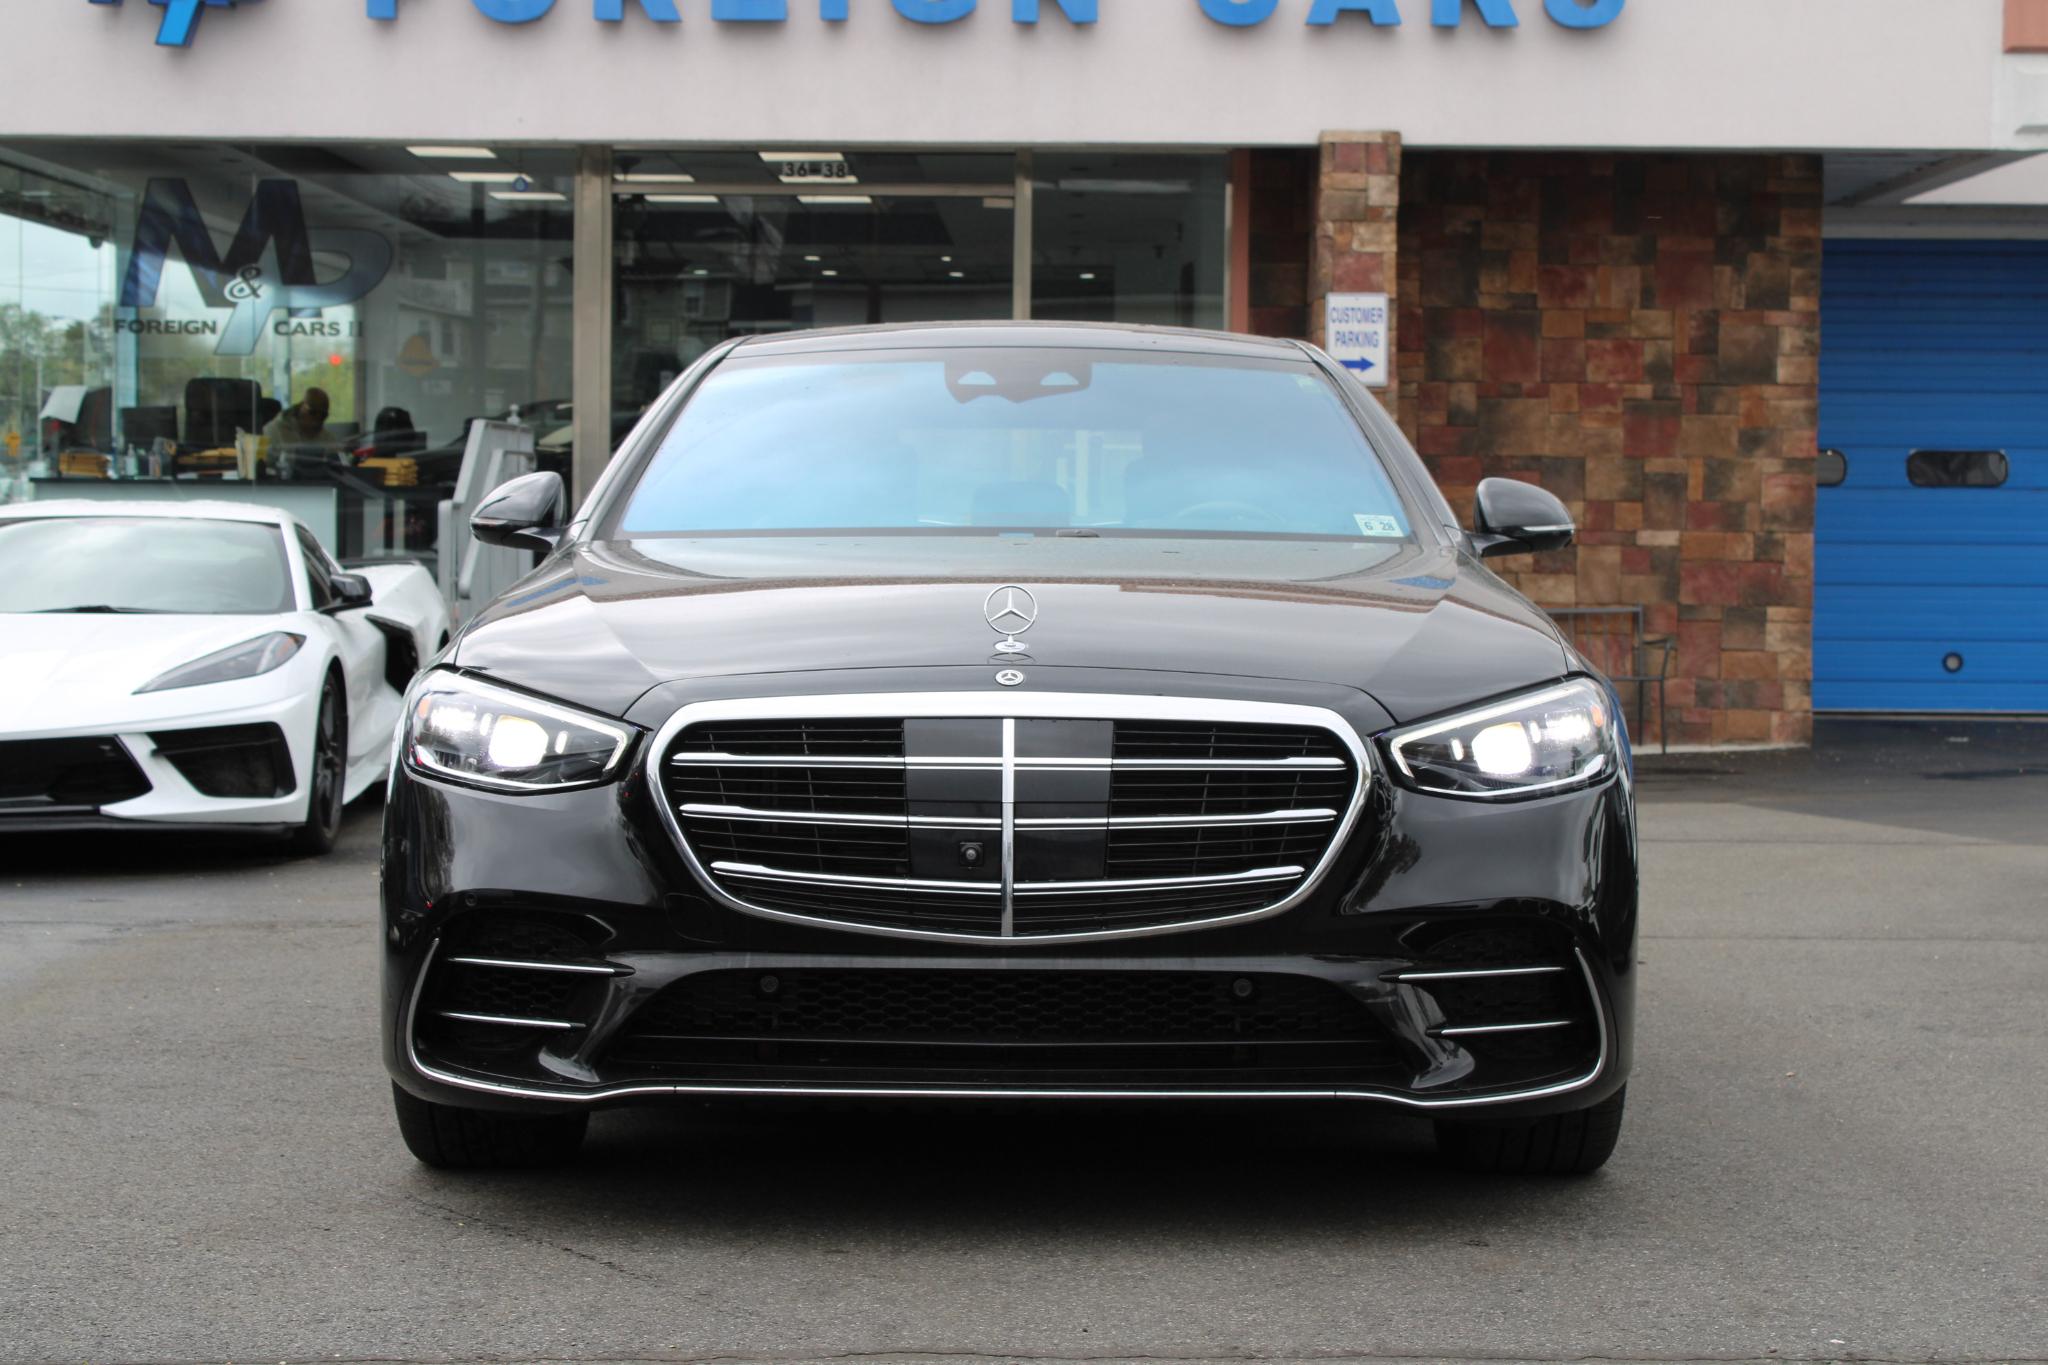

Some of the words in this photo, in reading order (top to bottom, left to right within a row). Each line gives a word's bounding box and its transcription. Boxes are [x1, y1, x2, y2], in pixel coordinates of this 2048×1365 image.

[784, 162, 847, 178] 36-38
[1329, 306, 1384, 324] CUSTOMER
[114, 319, 217, 335] FOREIGN
[274, 320, 341, 337] CARS
[1334, 331, 1380, 348] PARKING
